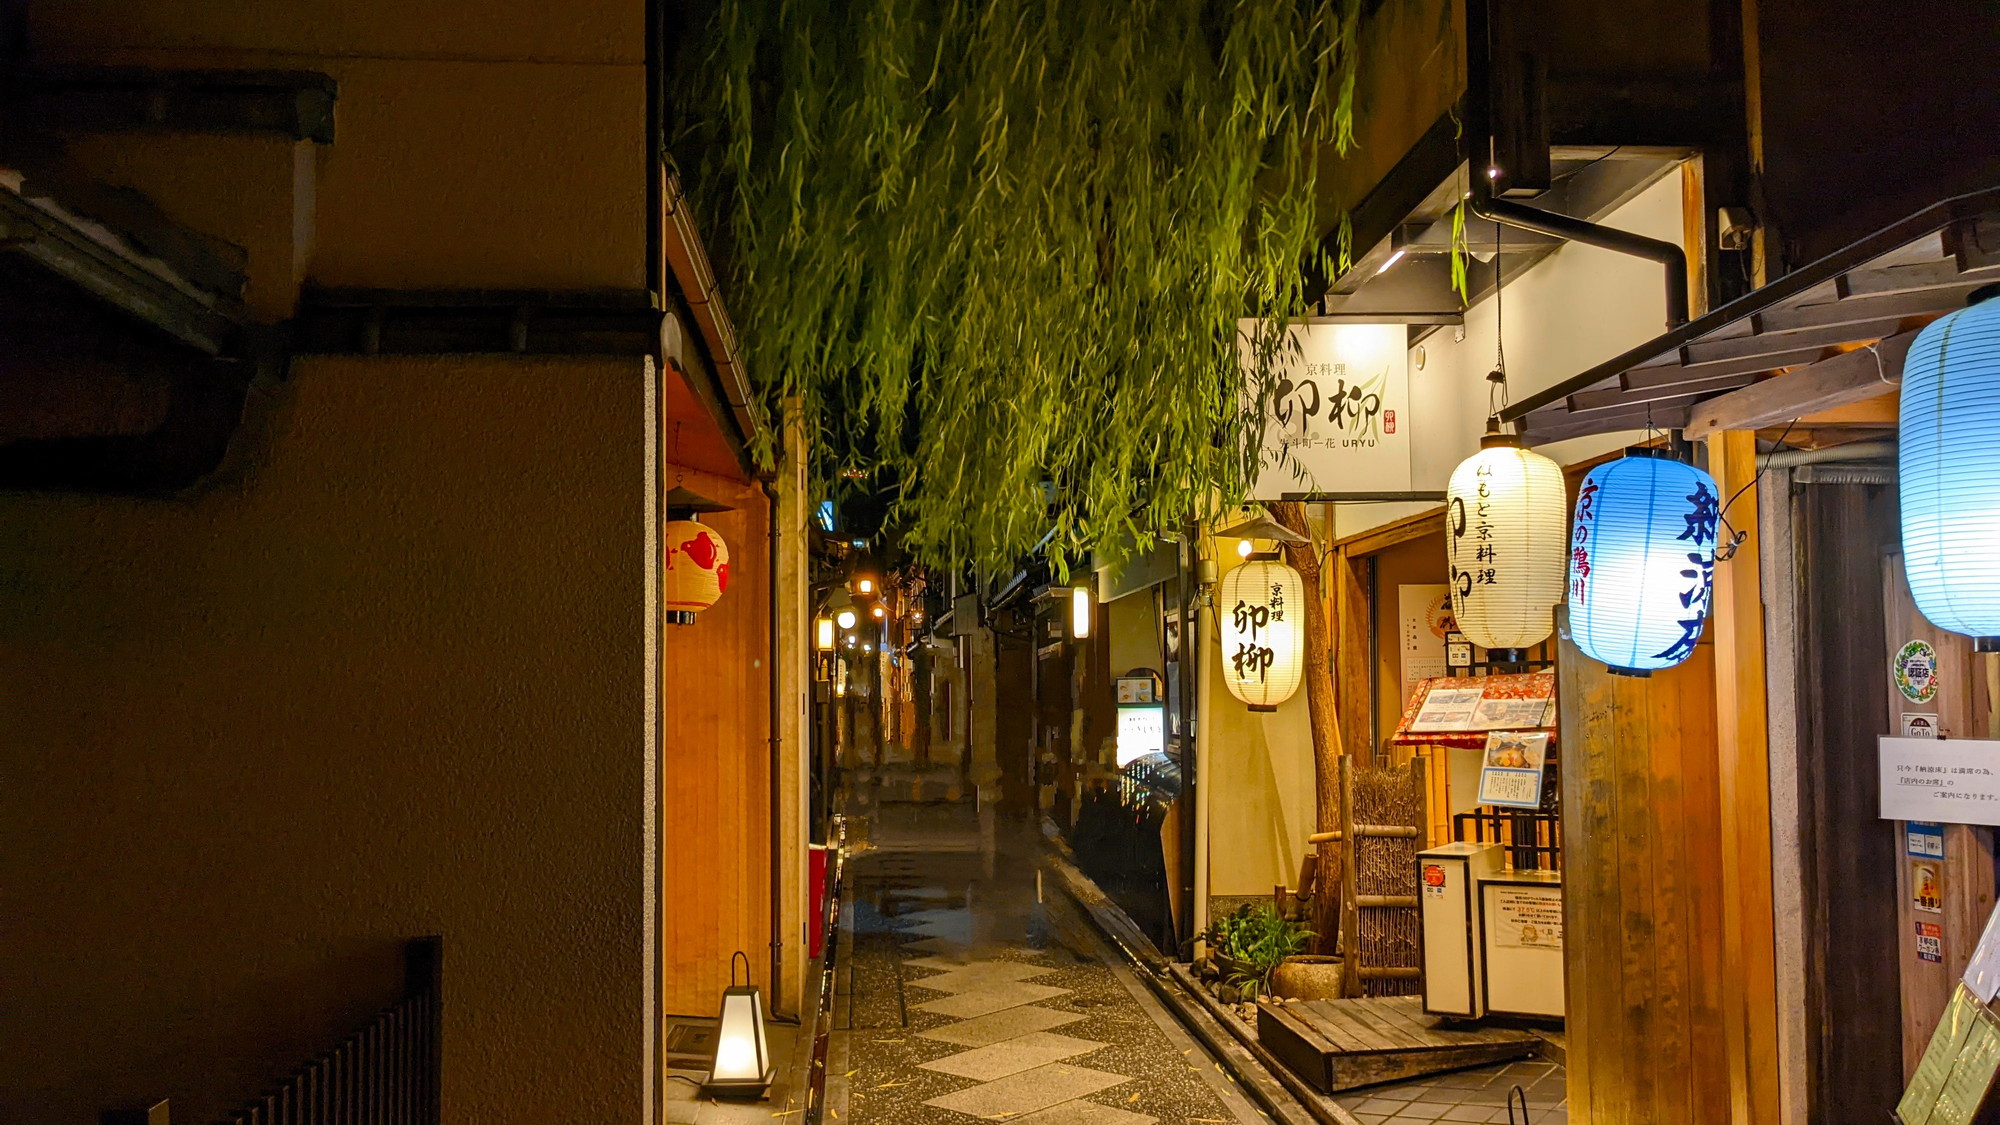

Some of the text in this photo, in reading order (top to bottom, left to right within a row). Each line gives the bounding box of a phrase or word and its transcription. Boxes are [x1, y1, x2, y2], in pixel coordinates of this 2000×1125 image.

[1305, 363, 1347, 376] 京料理
[1273, 379, 1380, 437] 卯柳
[1279, 437, 1376, 449] 先斗町一花 URYU
[1269, 582, 1284, 622] 京料理
[1231, 599, 1275, 685] 卯柳
[1933, 791, 1999, 801] ご案内になります。
